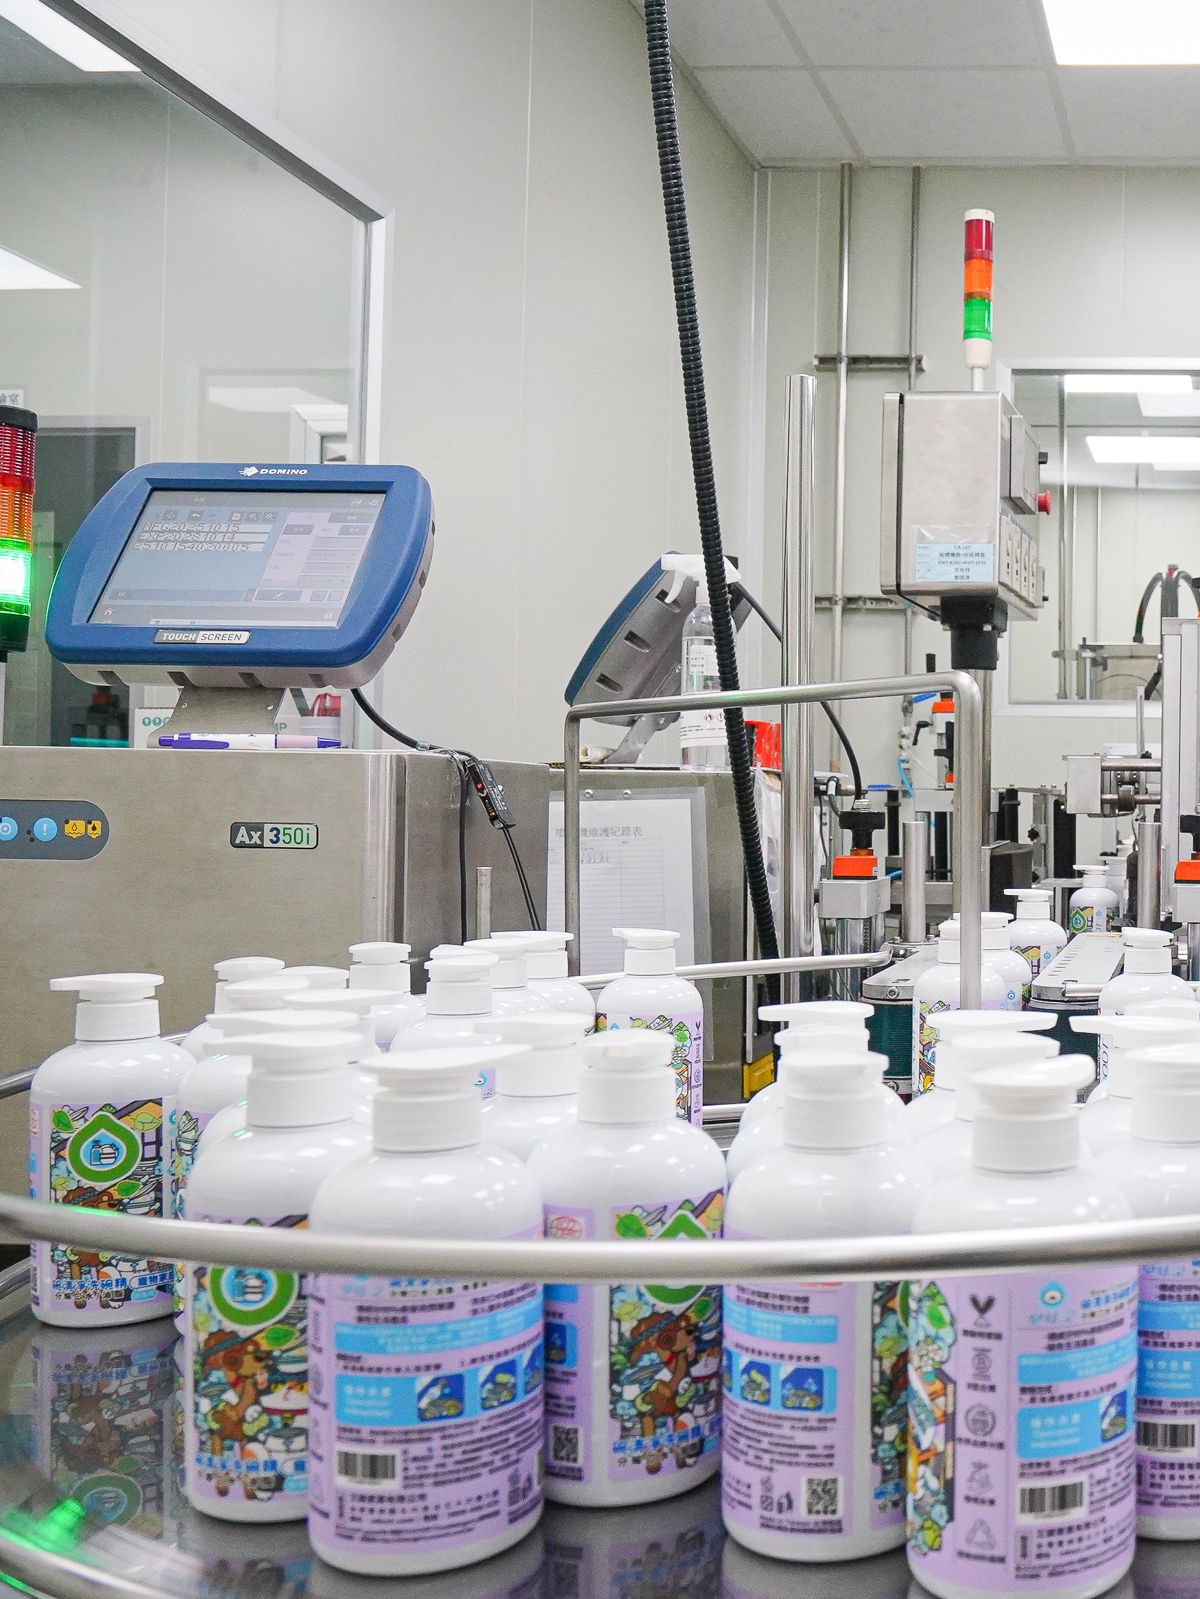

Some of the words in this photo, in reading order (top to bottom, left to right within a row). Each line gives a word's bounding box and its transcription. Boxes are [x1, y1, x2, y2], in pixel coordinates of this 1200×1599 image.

[259, 468, 308, 476] DOMINO
[161, 632, 197, 642] TOUCH
[200, 633, 243, 642] SCREEN
[234, 826, 262, 845] Ax
[269, 826, 311, 846] 350i
